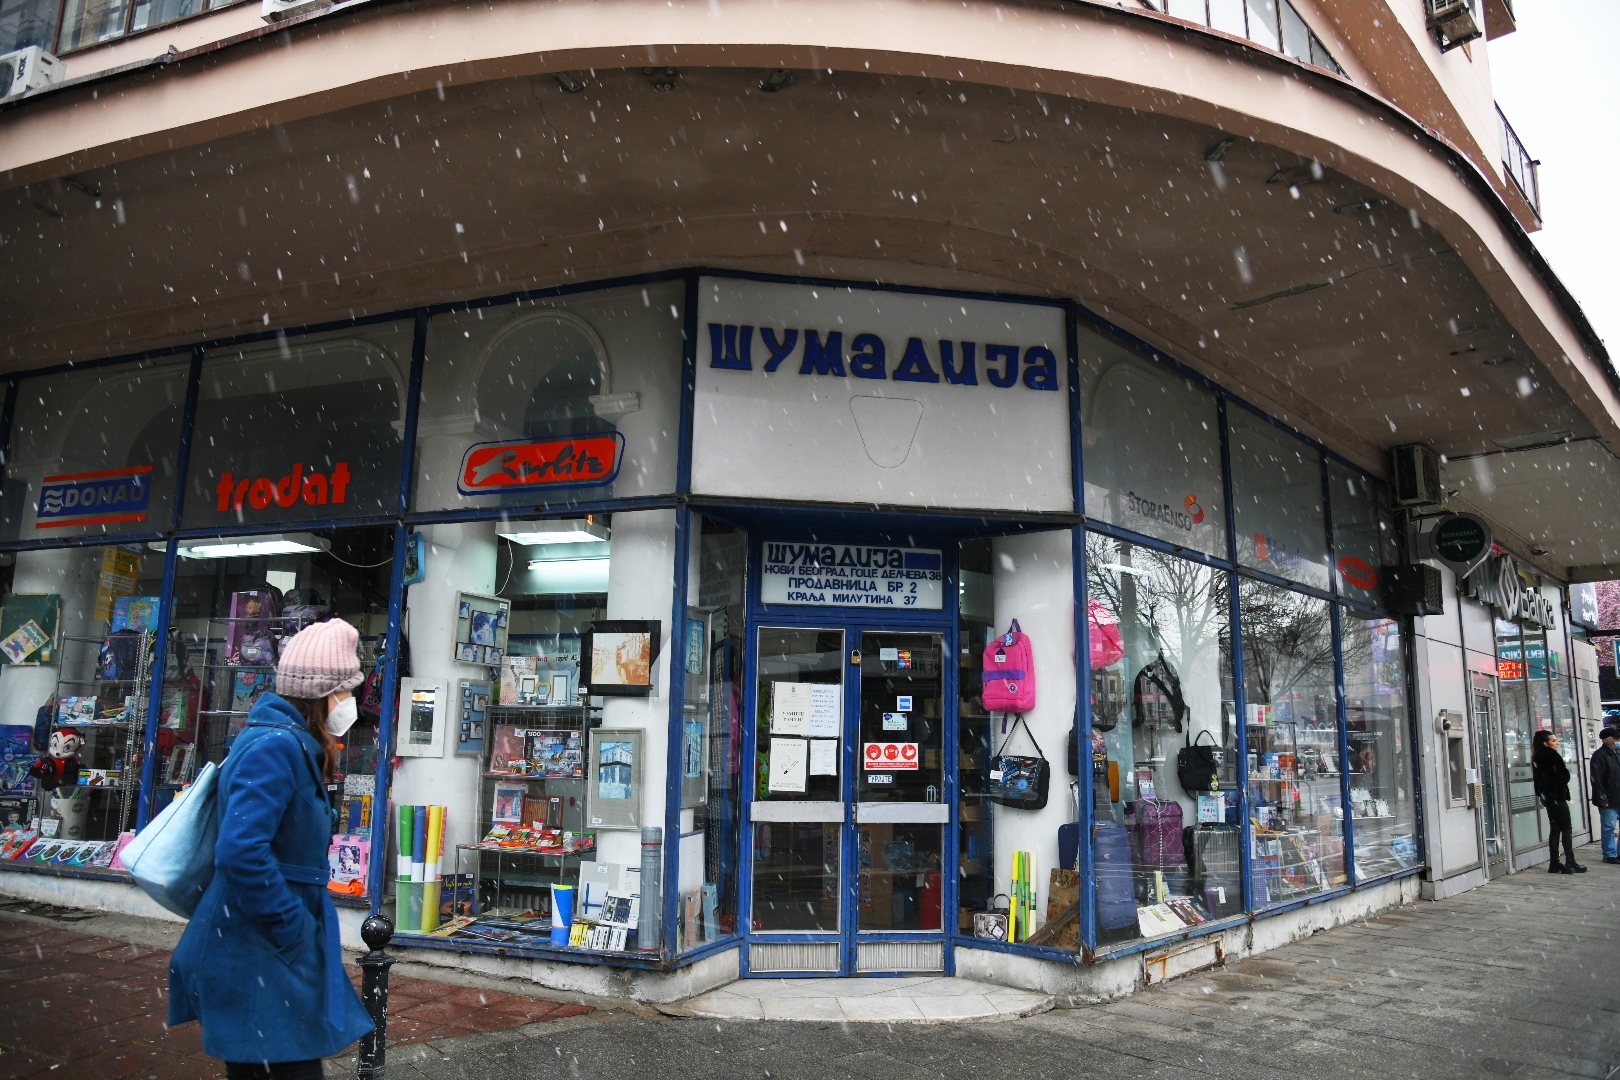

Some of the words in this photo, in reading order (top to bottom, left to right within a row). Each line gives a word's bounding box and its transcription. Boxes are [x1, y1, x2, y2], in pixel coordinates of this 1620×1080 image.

[16, 55, 27, 80] VOX
[64, 480, 147, 508] DONAU
[216, 461, 351, 513] trodat
[1441, 529, 1478, 539] BANKOMAT
[764, 565, 795, 576] НОВИ
[850, 568, 878, 578] ГОЦЕ
[881, 569, 928, 580] ДЕЛЧЕВА
[928, 571, 942, 581] 36
[788, 577, 878, 592] ПРОДАВНИЦА
[909, 581, 918, 594] 2
[787, 591, 826, 603] КРАЉА
[832, 594, 894, 605] МИЛУТИНА
[903, 595, 918, 606] 37
